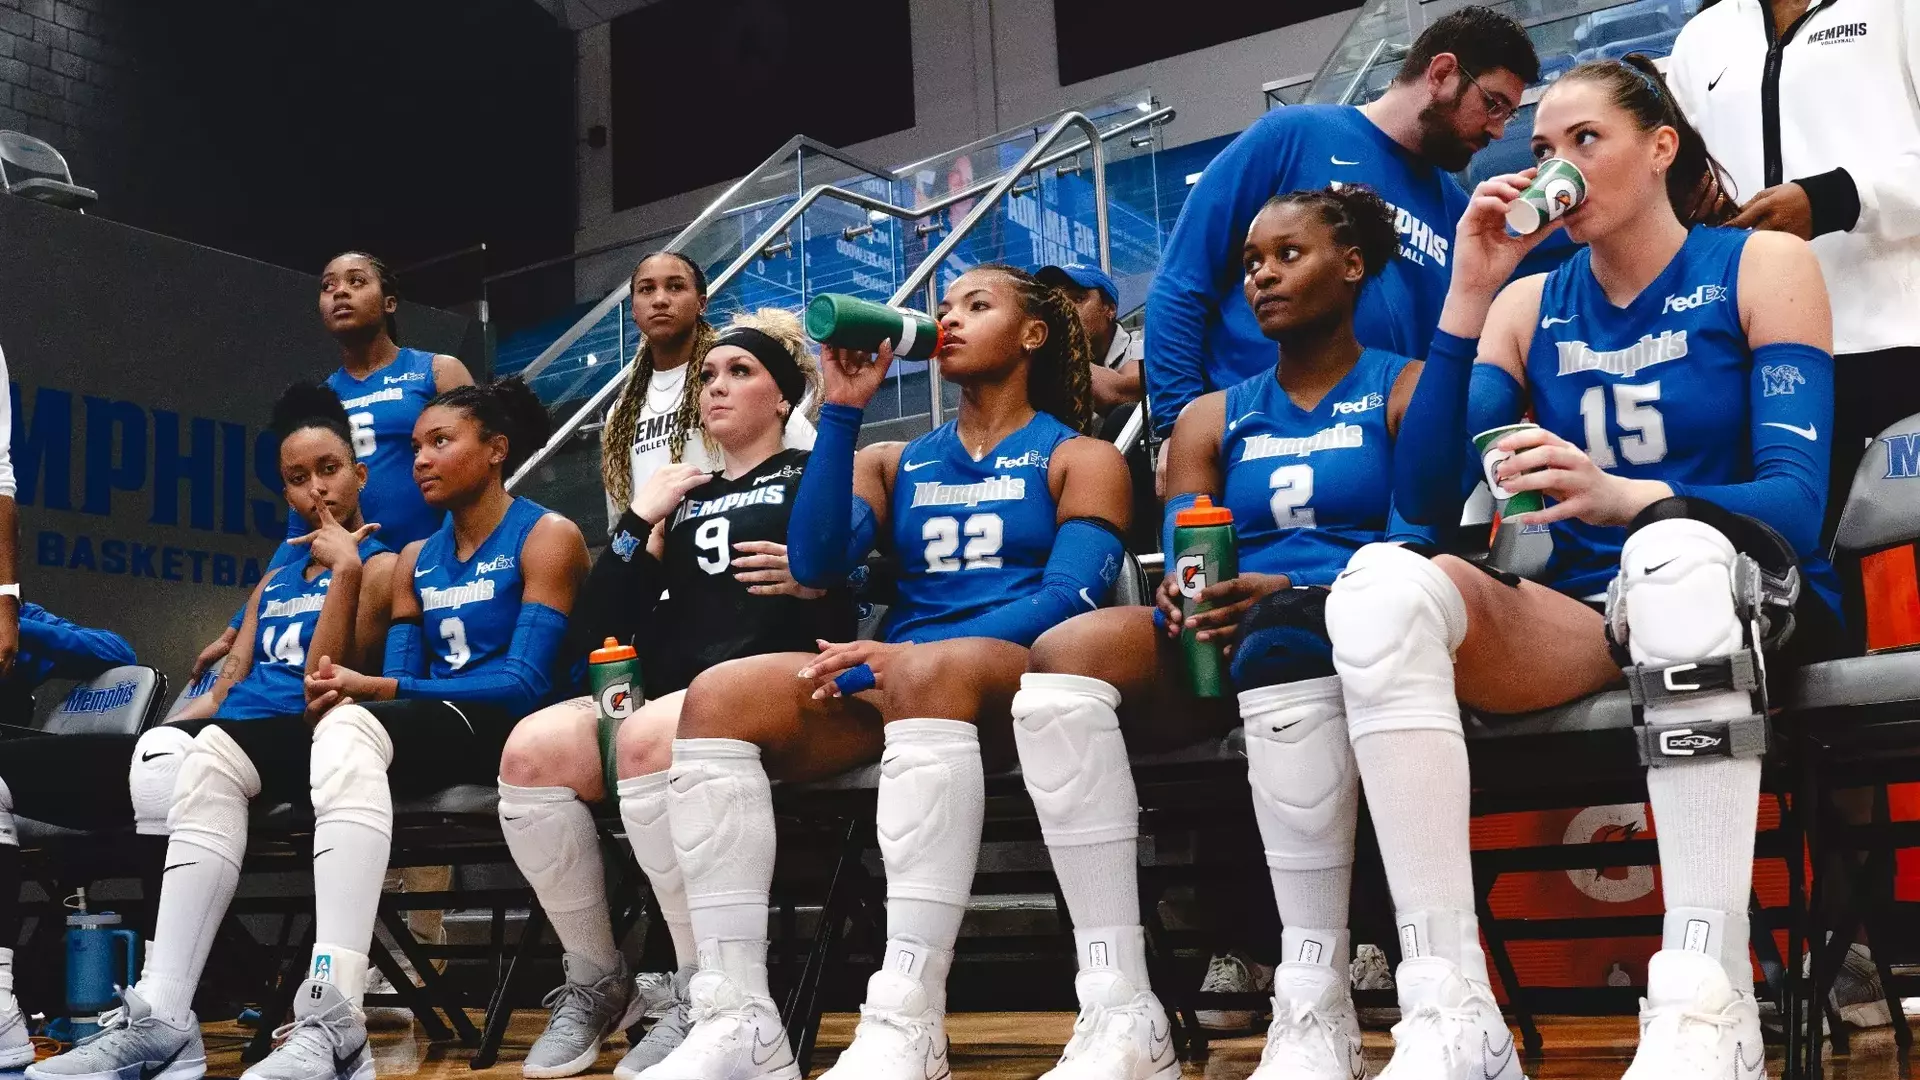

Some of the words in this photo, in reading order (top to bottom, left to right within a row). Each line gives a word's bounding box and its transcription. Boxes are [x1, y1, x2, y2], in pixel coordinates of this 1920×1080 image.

[1807, 22, 1867, 45] MEMPHIS
[1385, 201, 1448, 267] PHIS
[1662, 285, 1727, 315] FedEx
[1556, 330, 1688, 378] Memphis
[1239, 423, 1363, 462] Memphis
[1579, 380, 1668, 470] 15
[994, 450, 1050, 470] FedEx
[910, 475, 1025, 509] Memphis
[1269, 463, 1317, 530] 2
[37, 531, 262, 589] BASKETBA
[694, 516, 731, 576] 9
[921, 512, 1004, 574] 22
[475, 554, 516, 576] FedEx
[420, 578, 495, 613] Memphis
[259, 621, 305, 667] 14
[439, 616, 471, 671] 3
[60, 680, 138, 716] Memphis
[1669, 734, 1723, 749] DONJOY
